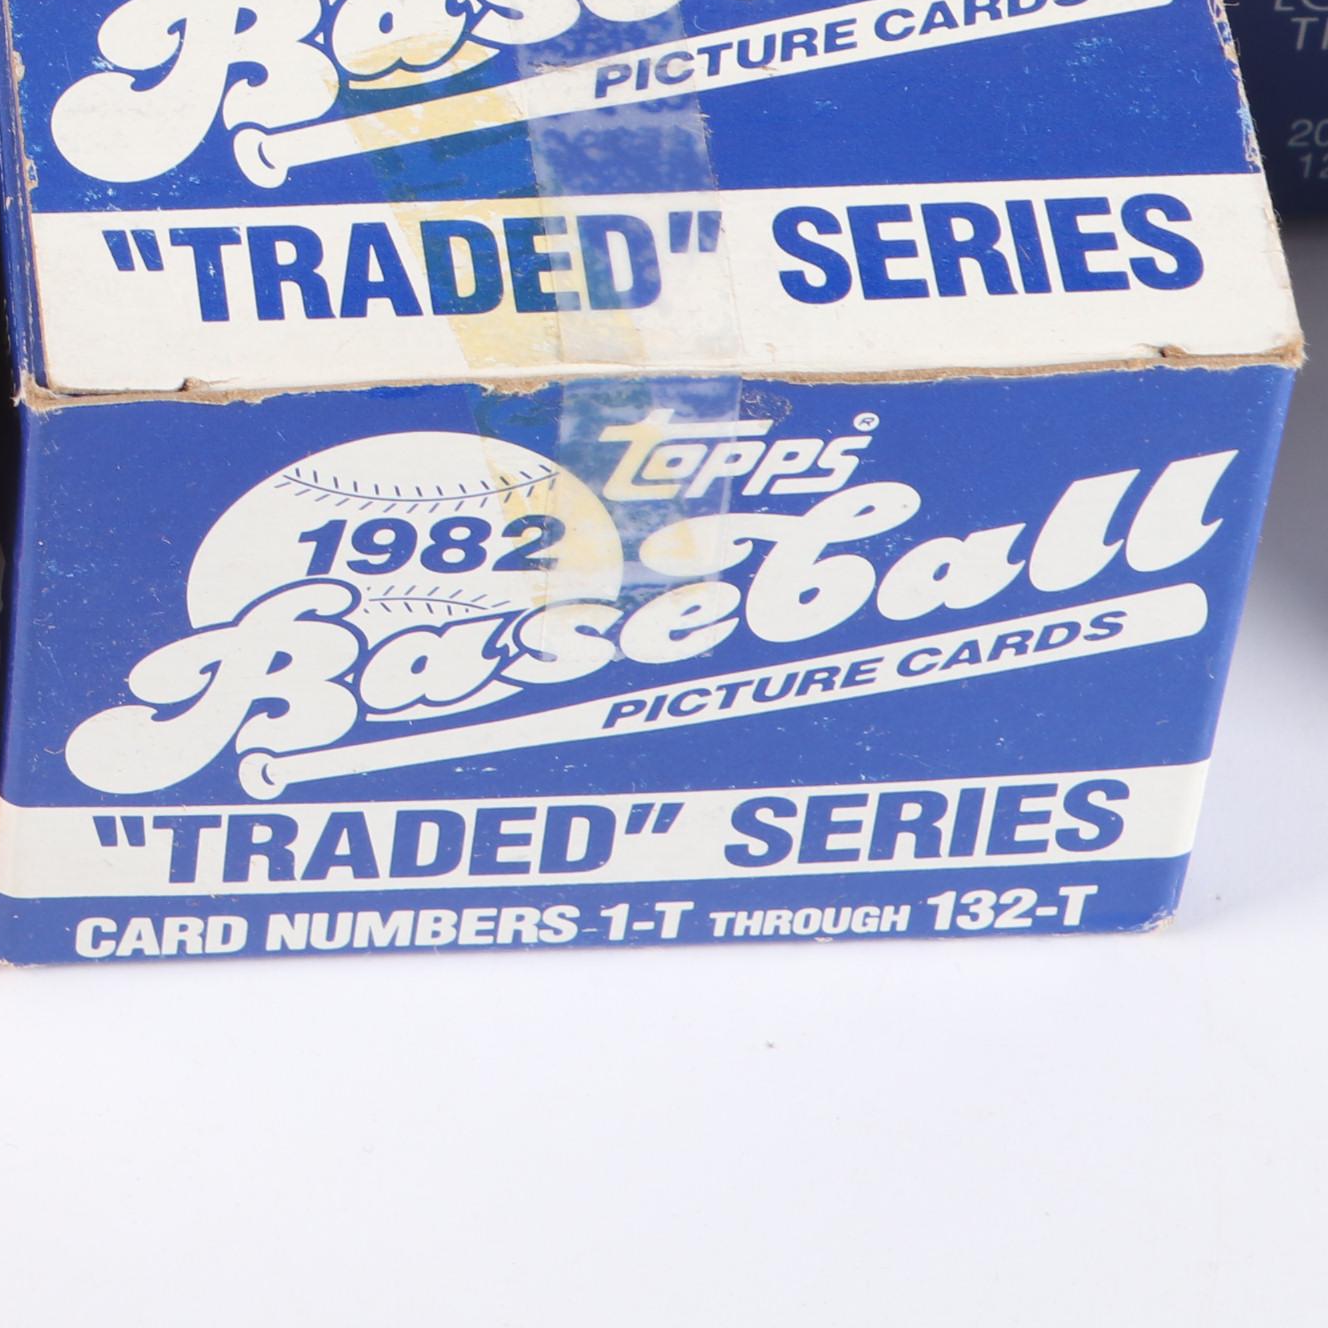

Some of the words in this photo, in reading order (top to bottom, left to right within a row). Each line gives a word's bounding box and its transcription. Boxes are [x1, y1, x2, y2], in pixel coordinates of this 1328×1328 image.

[595, 22, 861, 100] PICTURE
[102, 211, 723, 324] "TRADED"
[774, 191, 1208, 304] SERIES
[295, 516, 568, 577] 1982
[65, 449, 1239, 793] Baseball
[601, 657, 880, 731] PICTURE
[892, 609, 1127, 680] CARDS
[92, 802, 685, 885] "TRADED"
[722, 778, 1132, 868] SERIES
[74, 914, 254, 960] CARD
[264, 904, 580, 954] NUMBERS
[598, 901, 695, 943] 1-T
[708, 903, 909, 938] THROUGH
[926, 884, 1099, 933] 132-T
